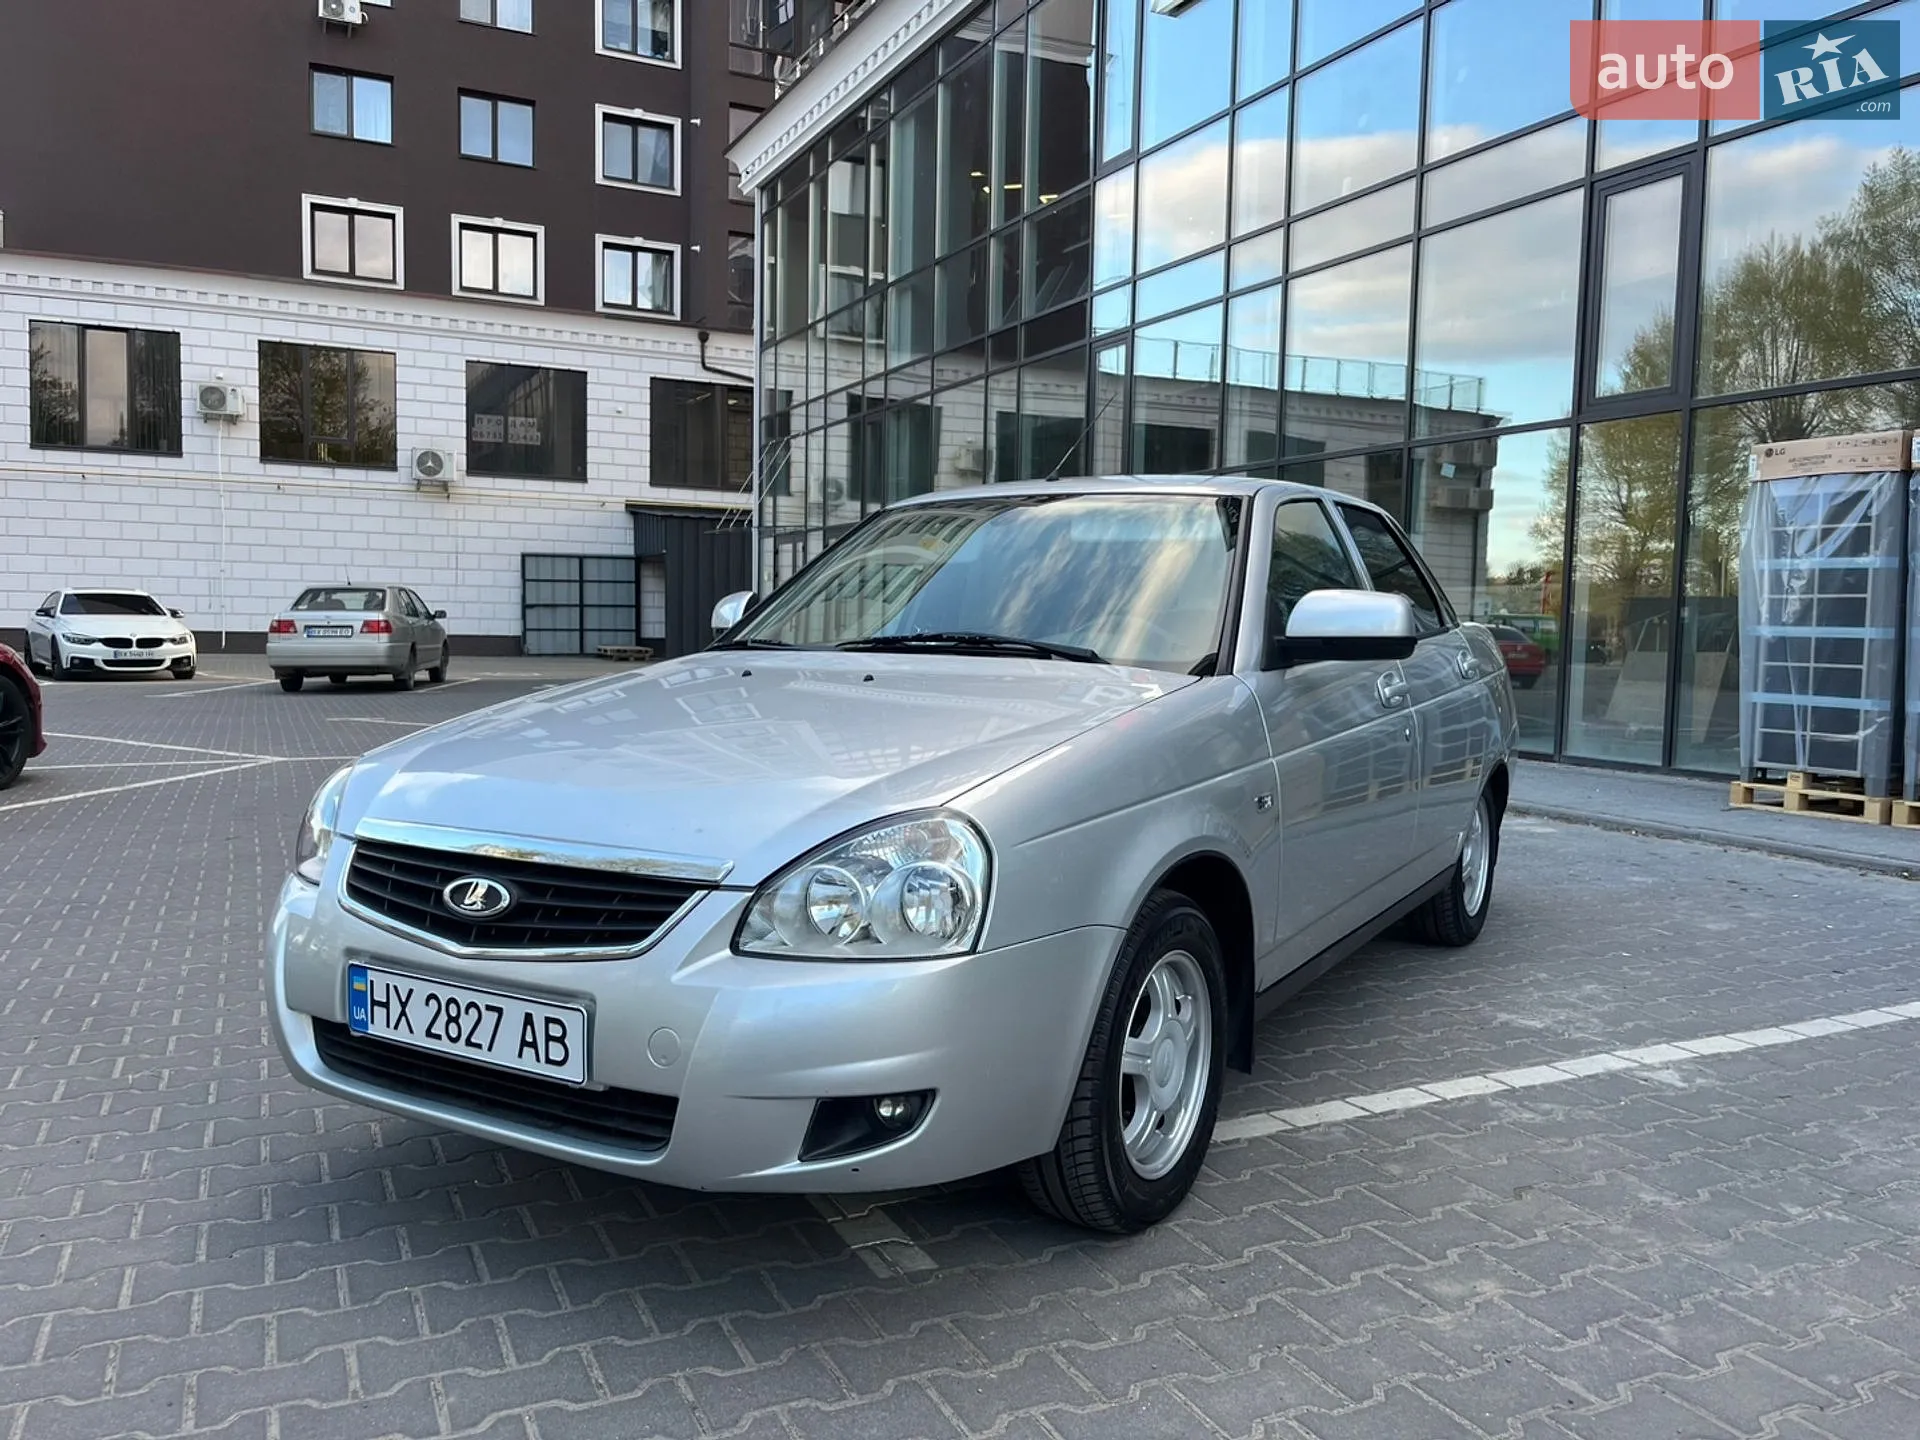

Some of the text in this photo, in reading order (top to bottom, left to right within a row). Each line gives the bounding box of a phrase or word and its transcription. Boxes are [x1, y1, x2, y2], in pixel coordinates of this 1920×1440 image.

[1775, 448, 1786, 456] LG
[353, 1006, 367, 1021] UA
[369, 979, 570, 1067] HX 2827 AB
